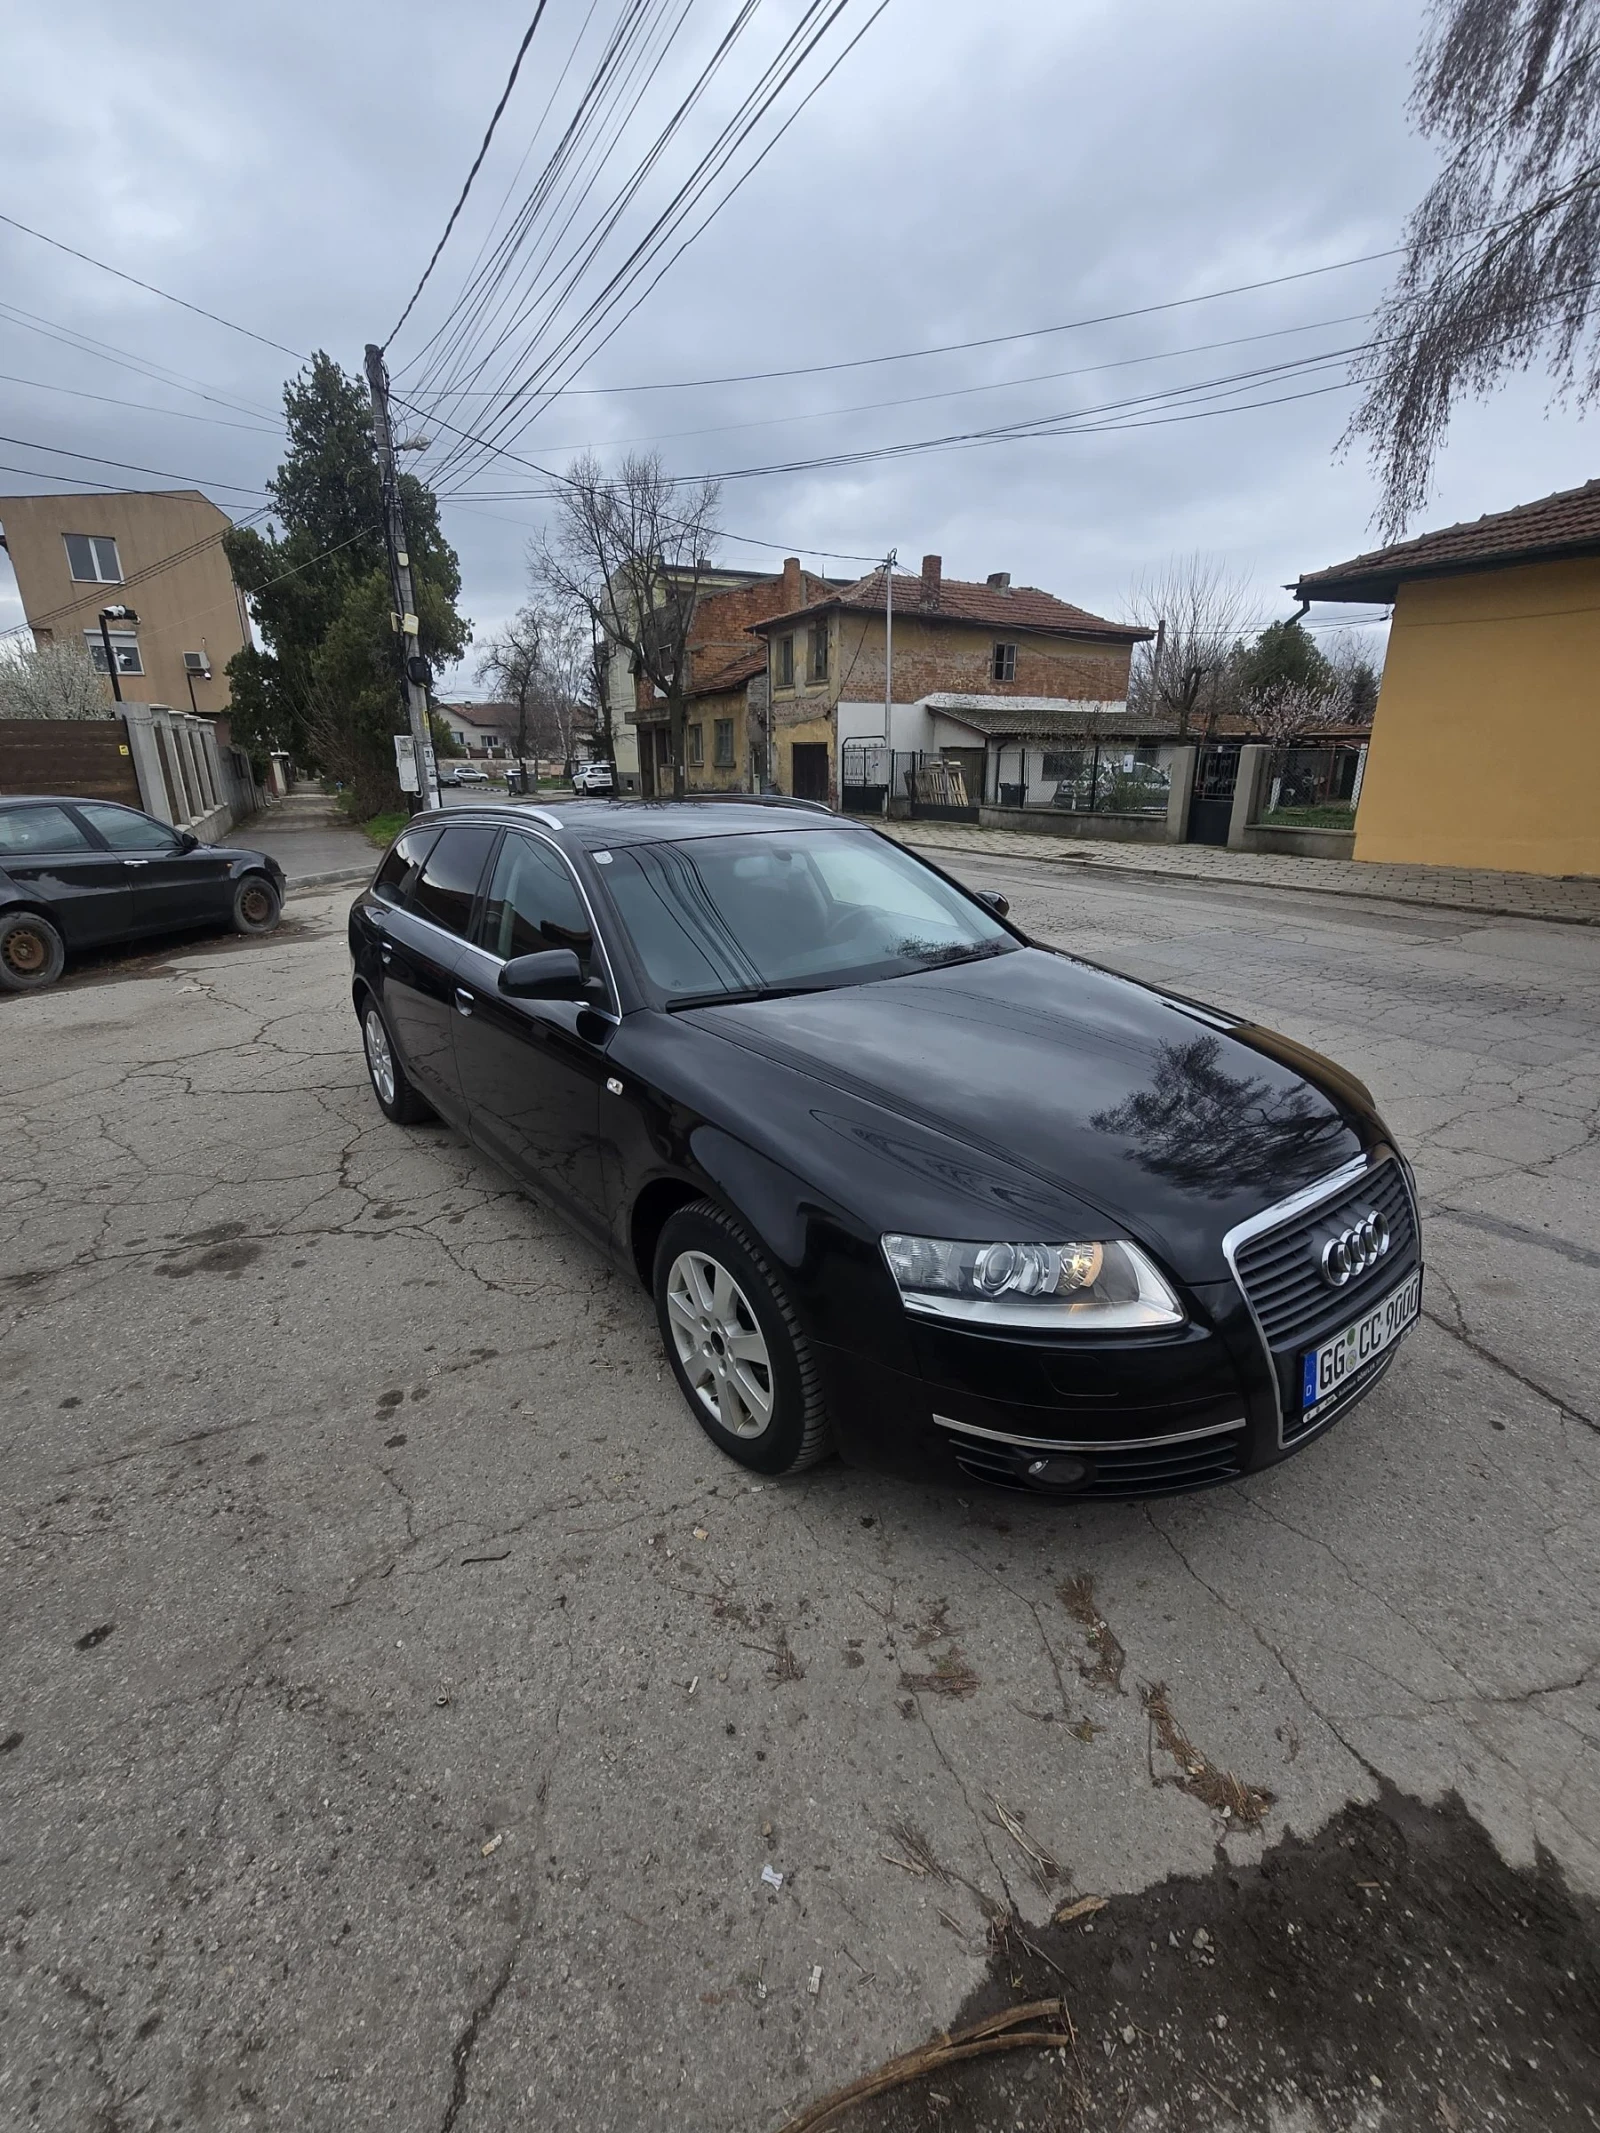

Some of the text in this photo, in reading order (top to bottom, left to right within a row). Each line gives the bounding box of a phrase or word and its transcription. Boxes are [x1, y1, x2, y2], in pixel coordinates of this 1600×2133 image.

[1306, 1384, 1312, 1397] D
[1320, 1338, 1345, 1390] GG
[1359, 1311, 1381, 1359] CC
[1386, 1277, 1418, 1340] 9000
